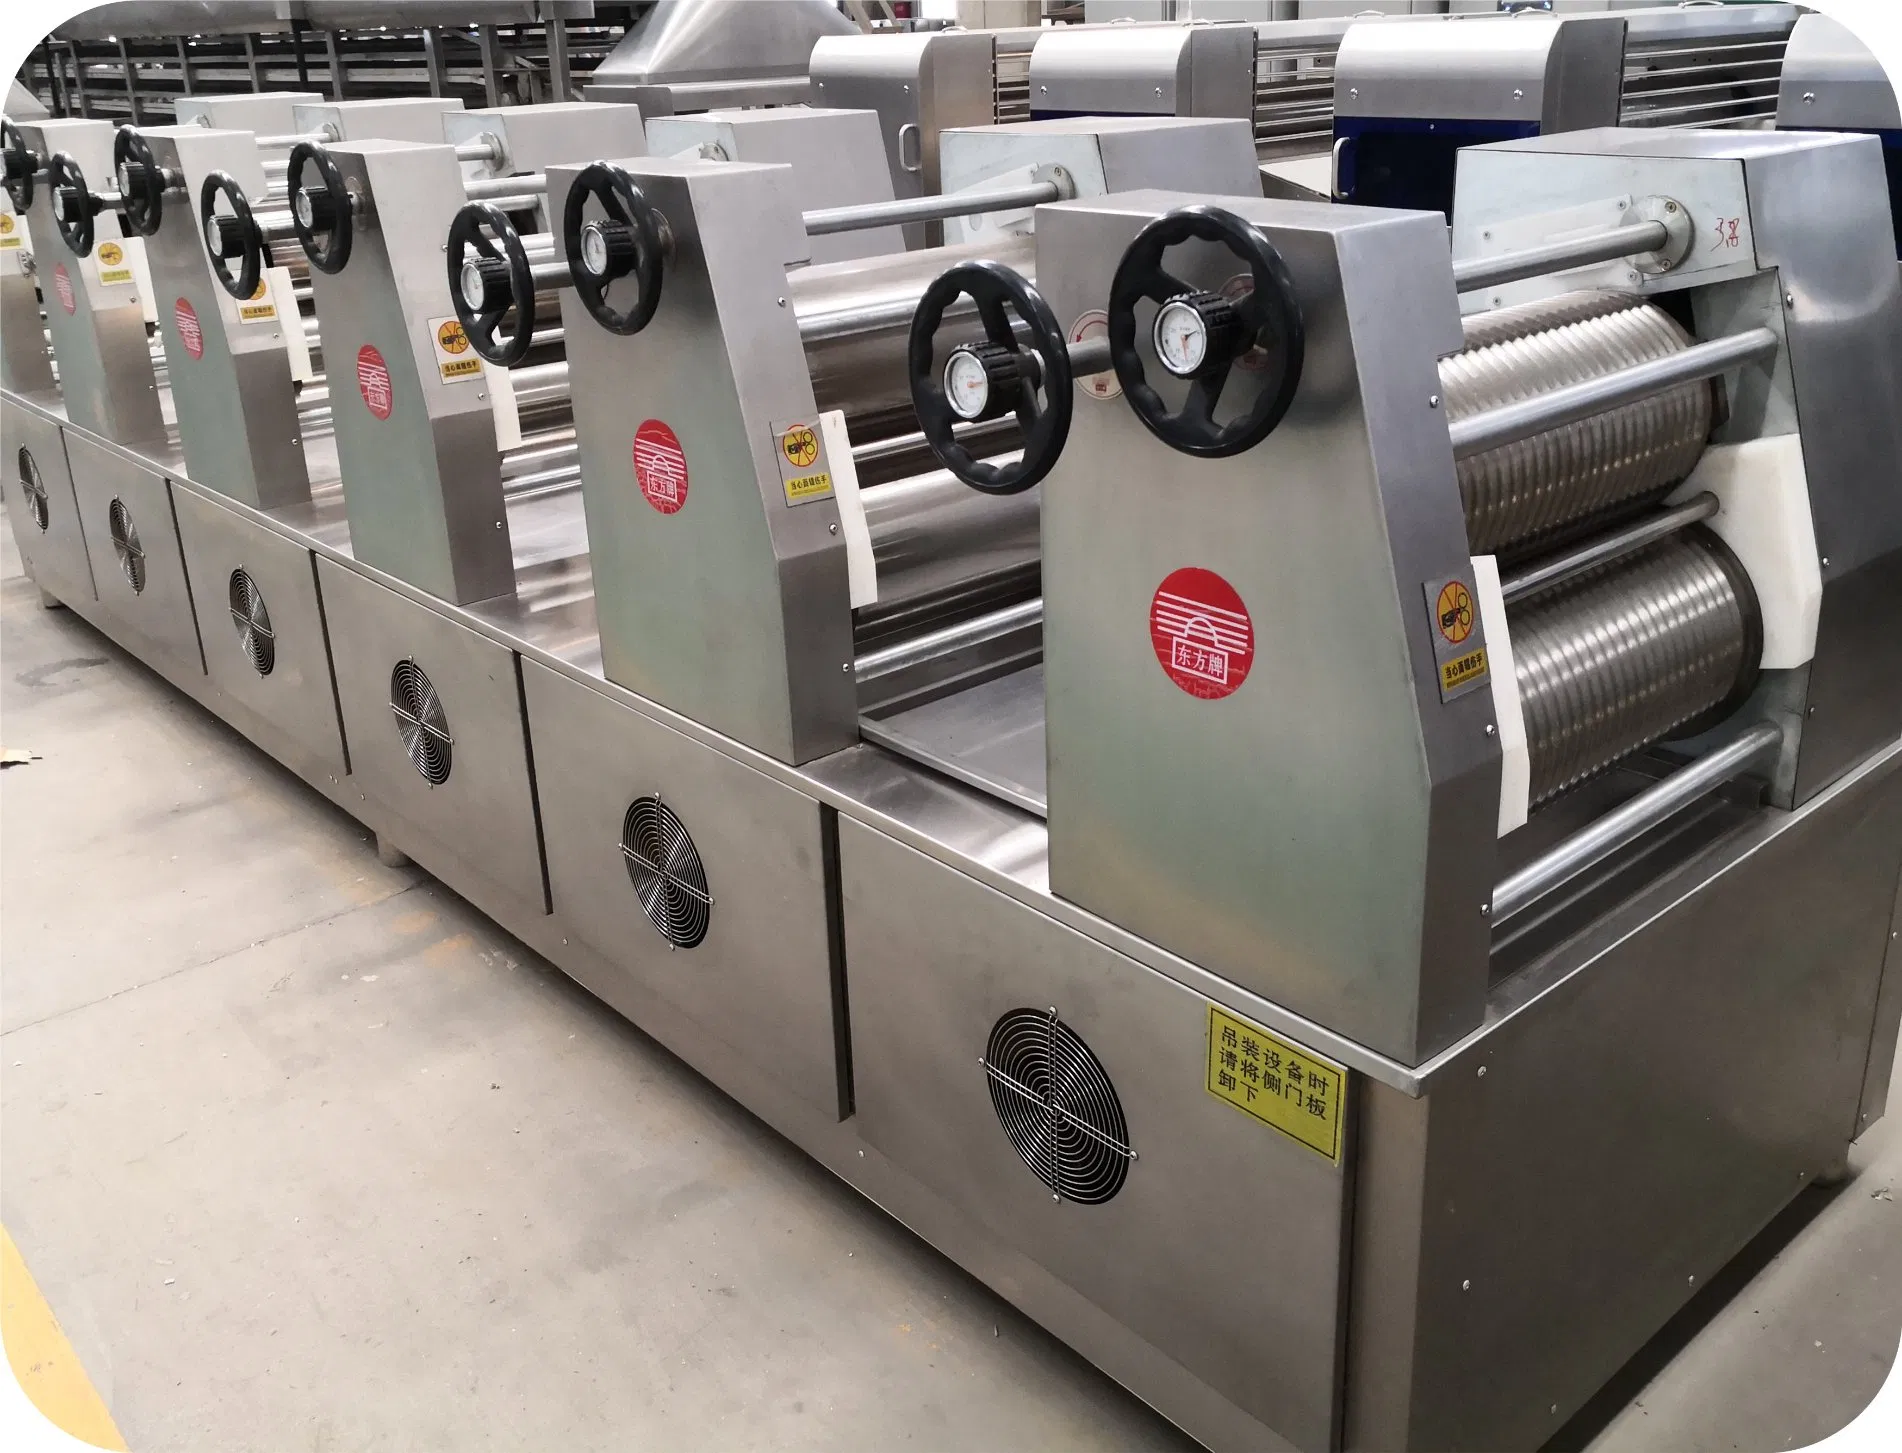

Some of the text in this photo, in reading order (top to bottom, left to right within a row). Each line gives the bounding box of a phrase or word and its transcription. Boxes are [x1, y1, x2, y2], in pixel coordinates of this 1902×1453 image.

[1177, 644, 1224, 677] 东方牌
[1218, 1069, 1259, 1103] 卸下
[1219, 1047, 1327, 1121] 请将侧门板
[1221, 1025, 1329, 1097] 吊装设备时
